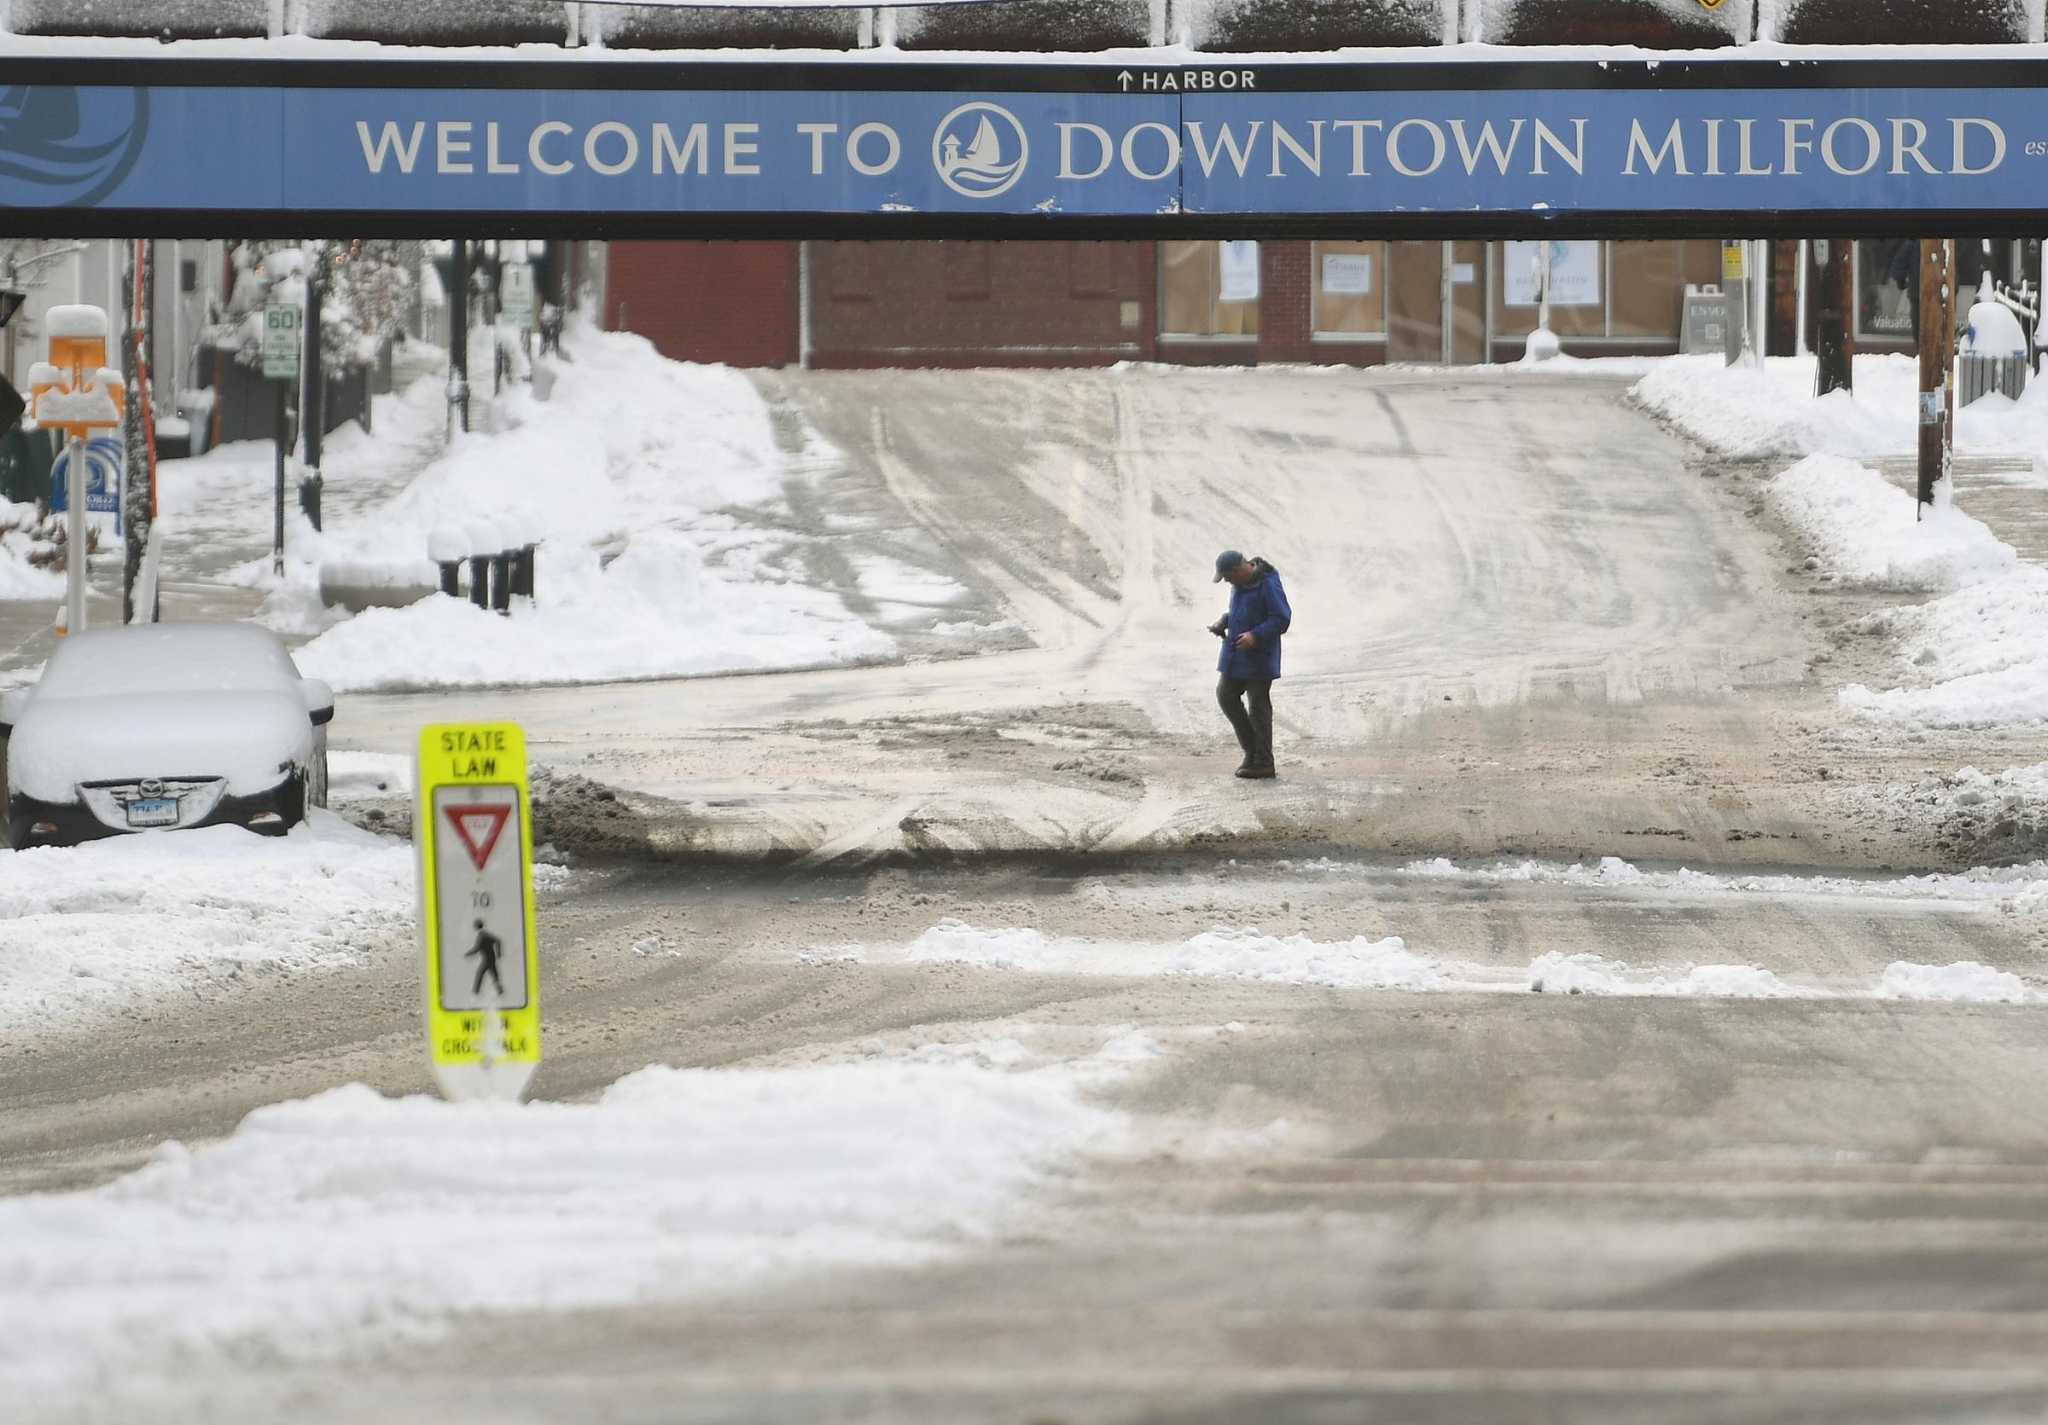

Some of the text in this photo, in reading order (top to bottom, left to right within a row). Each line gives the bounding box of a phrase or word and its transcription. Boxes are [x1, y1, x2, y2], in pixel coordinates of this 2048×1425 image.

[1142, 70, 1255, 90] HARBOR
[356, 118, 2048, 179] WELCOME TO DOWNTOWN MILFORD es
[442, 731, 506, 752] STATE
[452, 757, 497, 777] LAW
